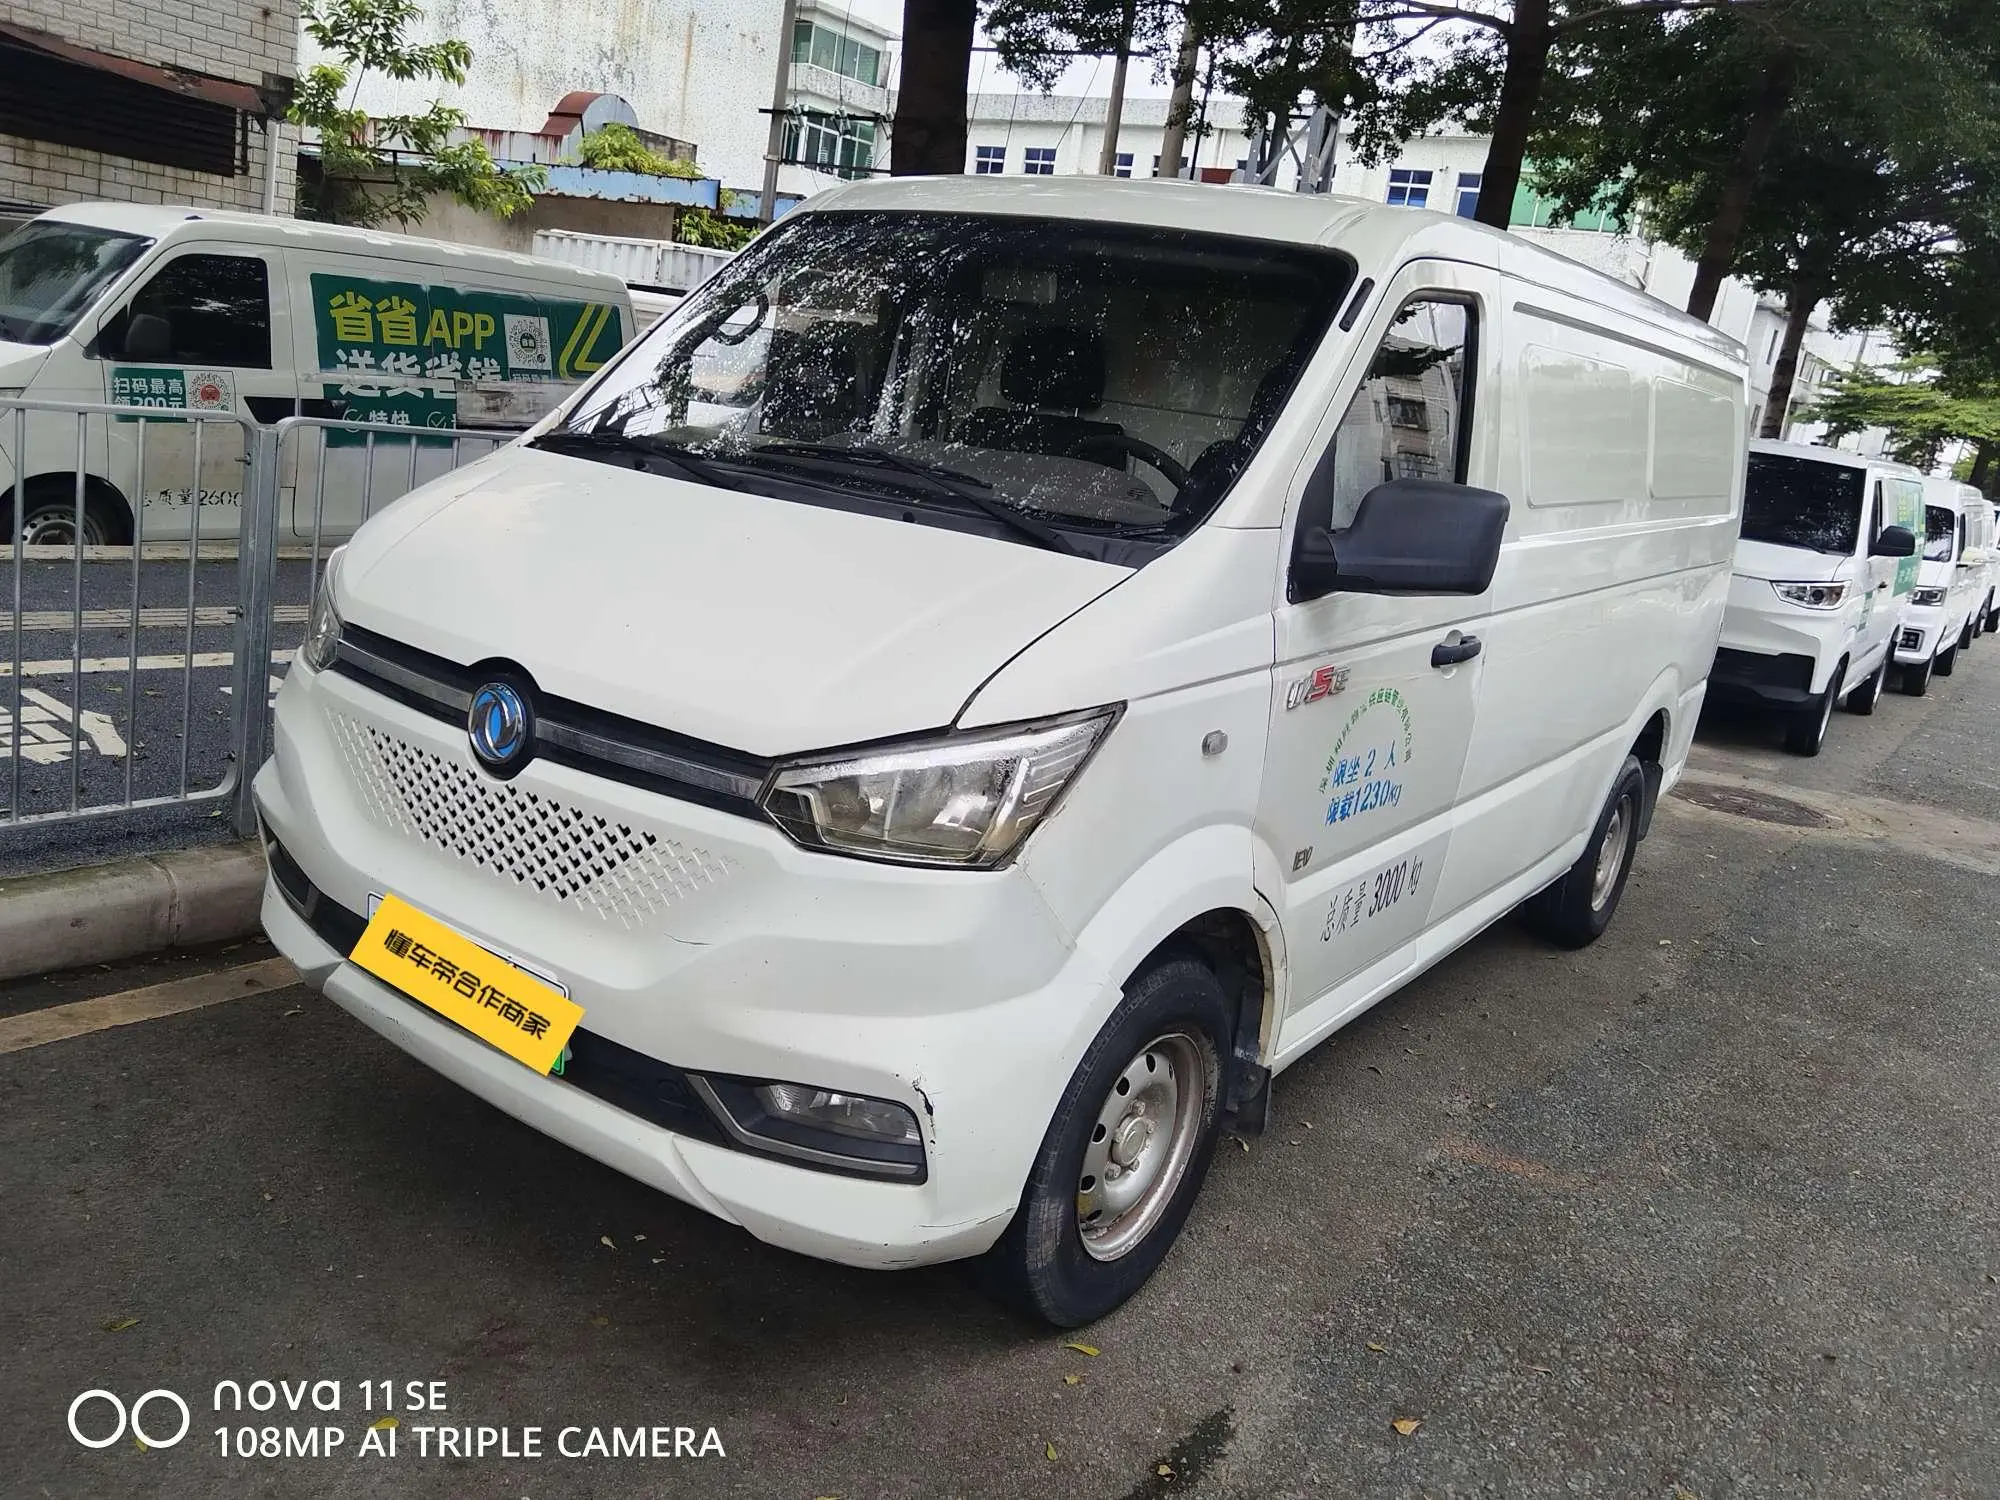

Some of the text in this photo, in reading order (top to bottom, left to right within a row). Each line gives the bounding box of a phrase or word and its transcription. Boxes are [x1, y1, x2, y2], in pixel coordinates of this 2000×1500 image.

[330, 292, 495, 350] 省省APP
[114, 377, 183, 394] 扫码最高
[1369, 860, 1407, 918] 3000
